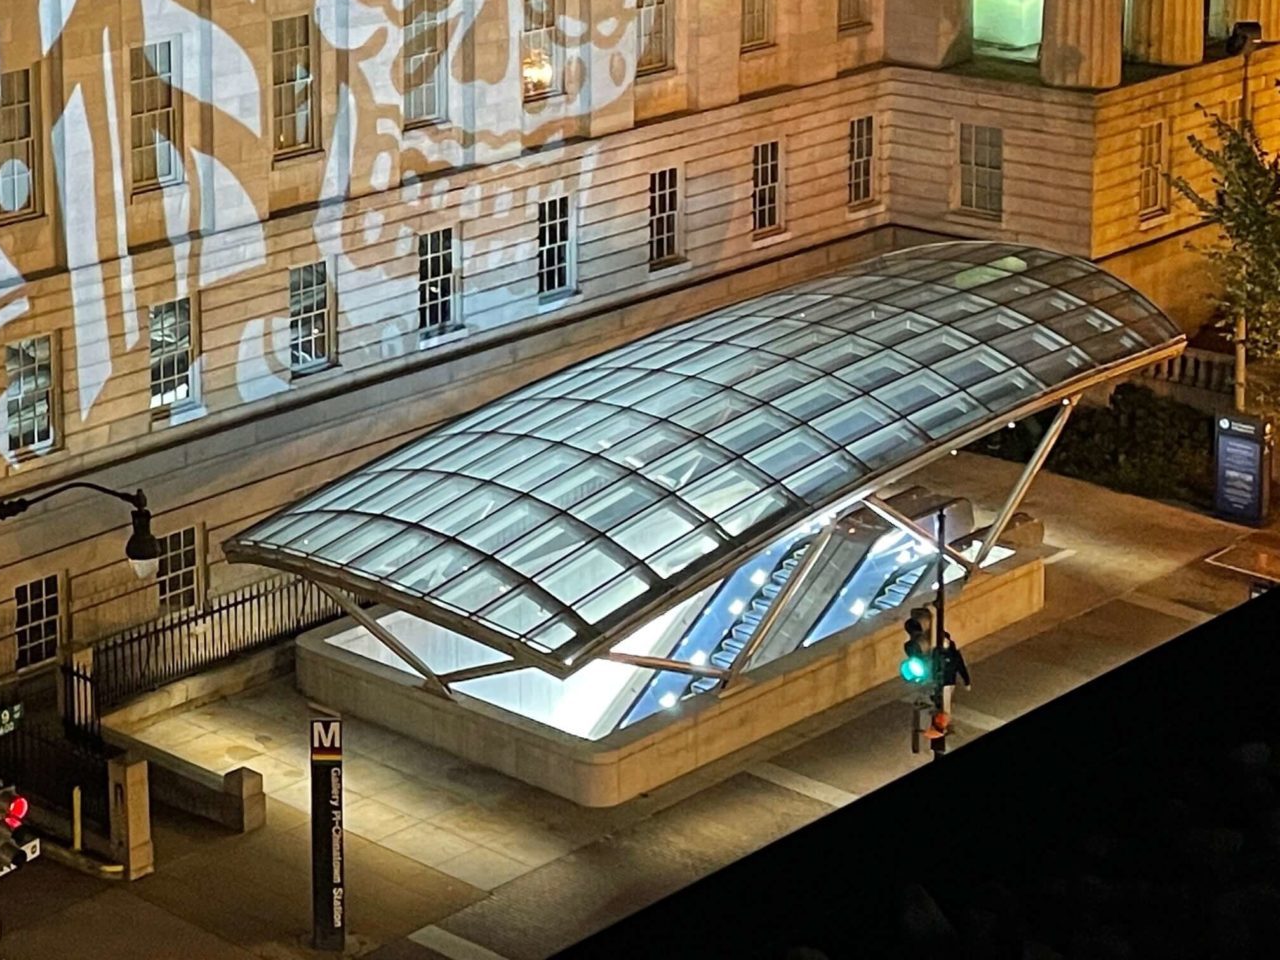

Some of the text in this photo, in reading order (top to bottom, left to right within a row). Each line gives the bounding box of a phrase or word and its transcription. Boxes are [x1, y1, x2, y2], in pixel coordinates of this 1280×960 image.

[1, 709, 10, 724] 9
[313, 722, 340, 748] M
[329, 767, 341, 807] Gallery
[332, 887, 343, 928] Station
